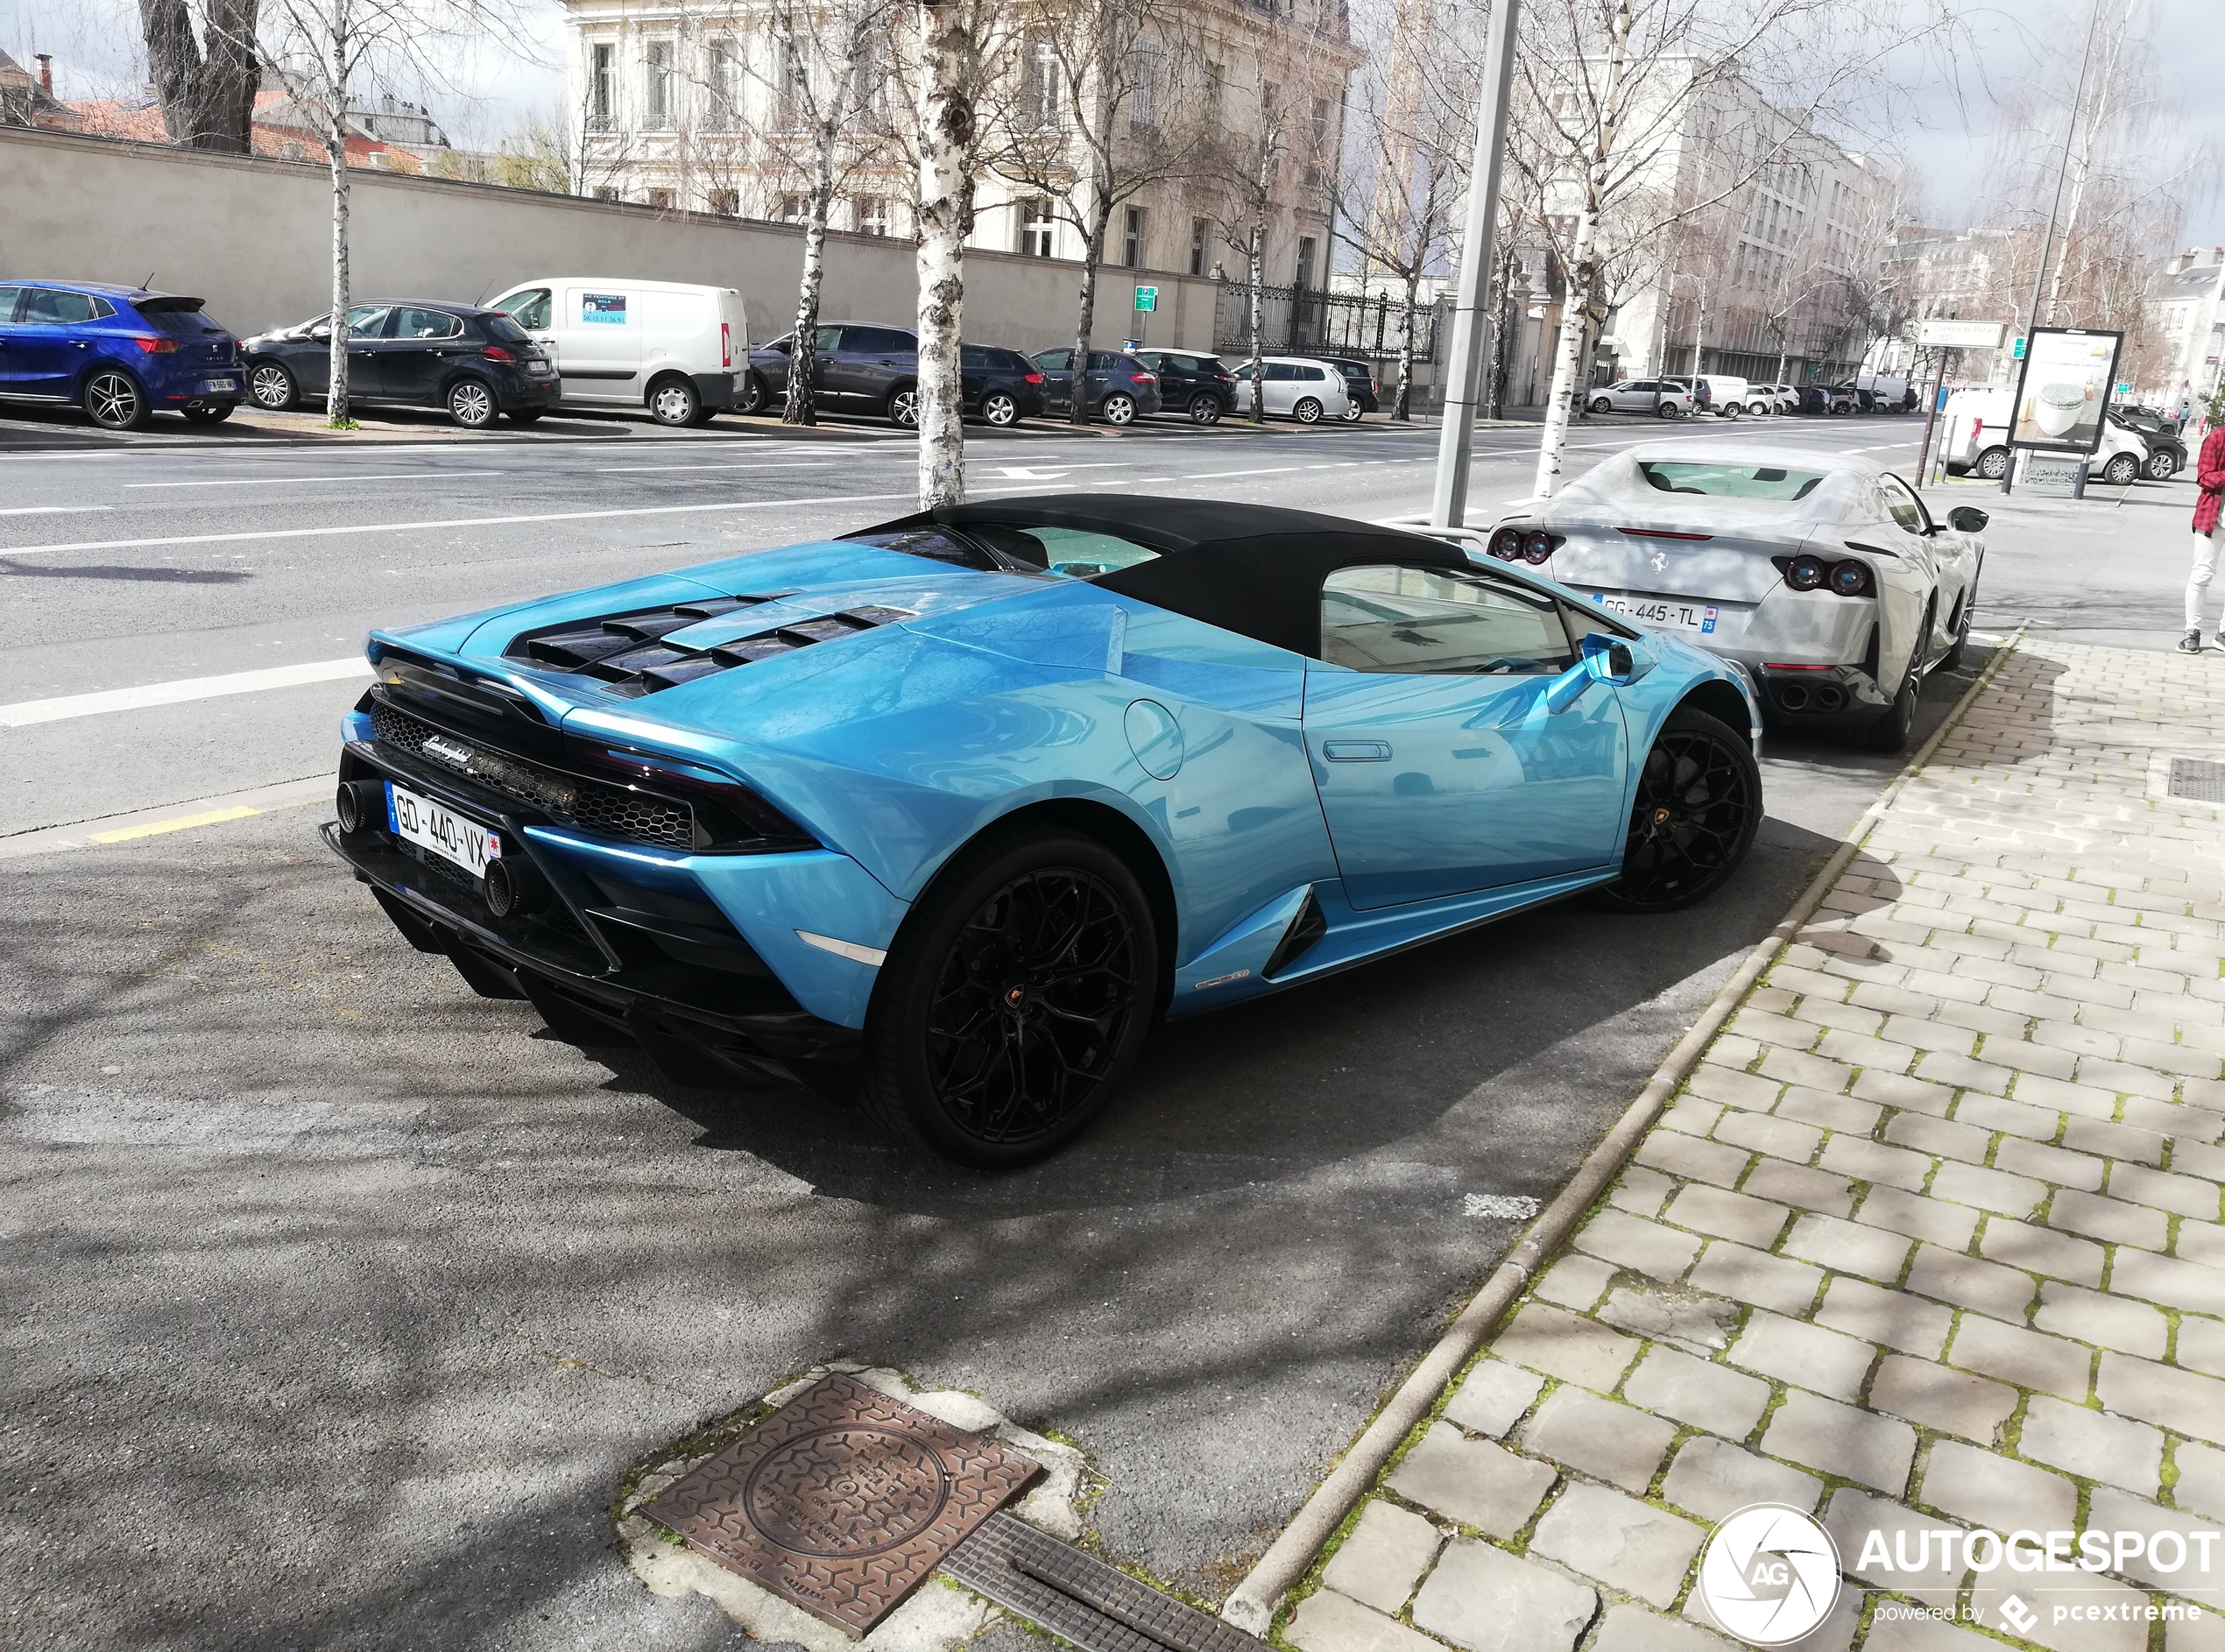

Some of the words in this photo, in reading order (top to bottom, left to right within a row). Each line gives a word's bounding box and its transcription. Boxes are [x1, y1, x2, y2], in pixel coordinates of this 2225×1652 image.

[1933, 324, 1961, 333] Chambre
[1704, 620, 1713, 630] 75
[422, 736, 472, 762] Lamborghini
[708, 1537, 747, 1562] 125
[744, 1557, 765, 1572] B
